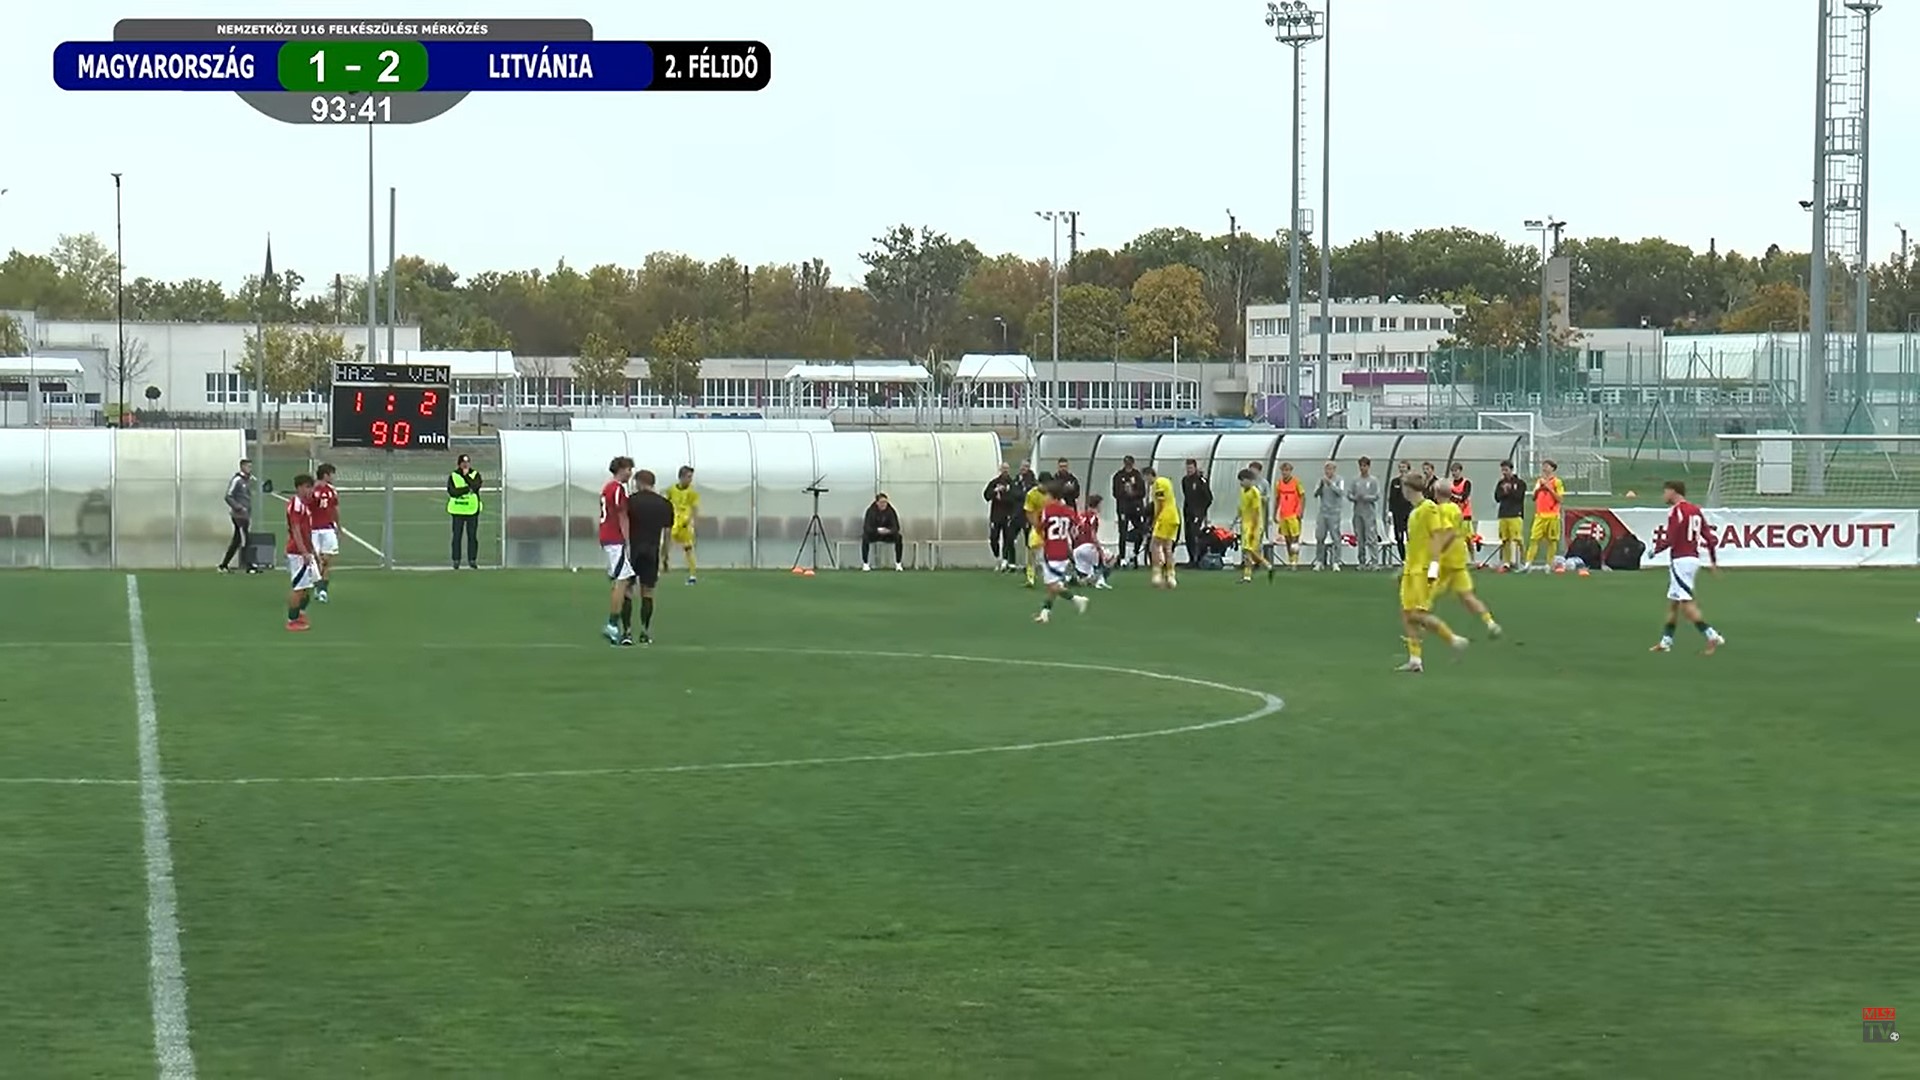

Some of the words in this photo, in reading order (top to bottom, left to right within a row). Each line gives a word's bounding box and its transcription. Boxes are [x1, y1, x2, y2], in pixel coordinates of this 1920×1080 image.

[336, 366, 375, 380] HAZ
[408, 368, 447, 382] VEN
[356, 392, 362, 412] 1
[420, 391, 437, 415] 2
[371, 421, 410, 445] 90
[418, 433, 446, 444] min
[1048, 516, 1070, 540] 20
[1653, 524, 1895, 548] #SAKEGYUTT
